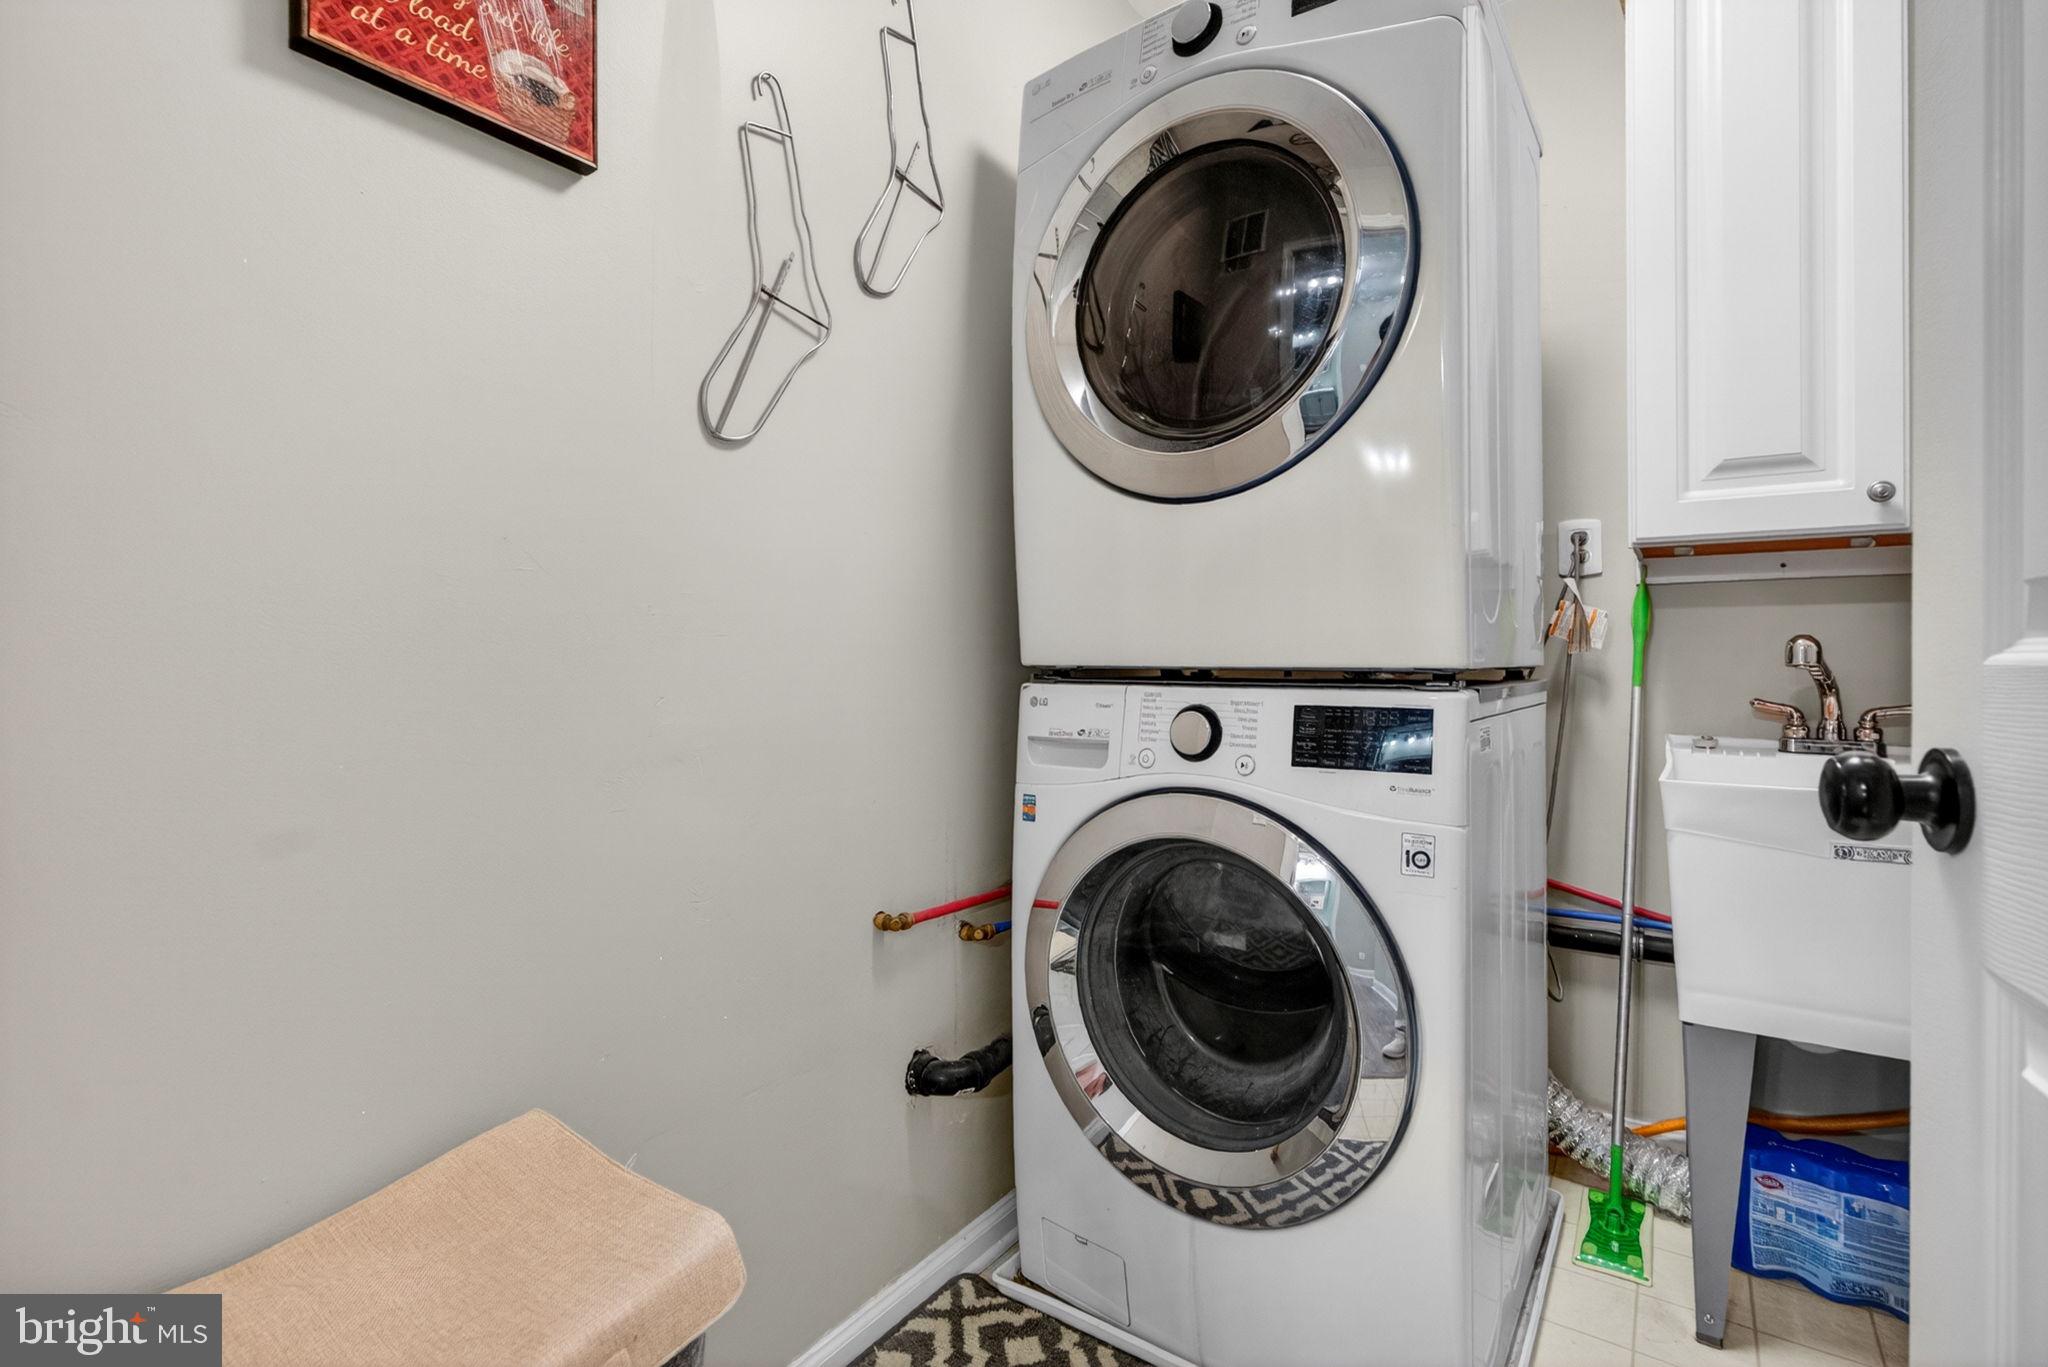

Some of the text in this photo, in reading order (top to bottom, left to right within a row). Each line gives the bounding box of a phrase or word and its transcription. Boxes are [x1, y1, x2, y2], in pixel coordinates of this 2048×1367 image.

[351, 6, 488, 80] at a time
[409, 0, 475, 42] load
